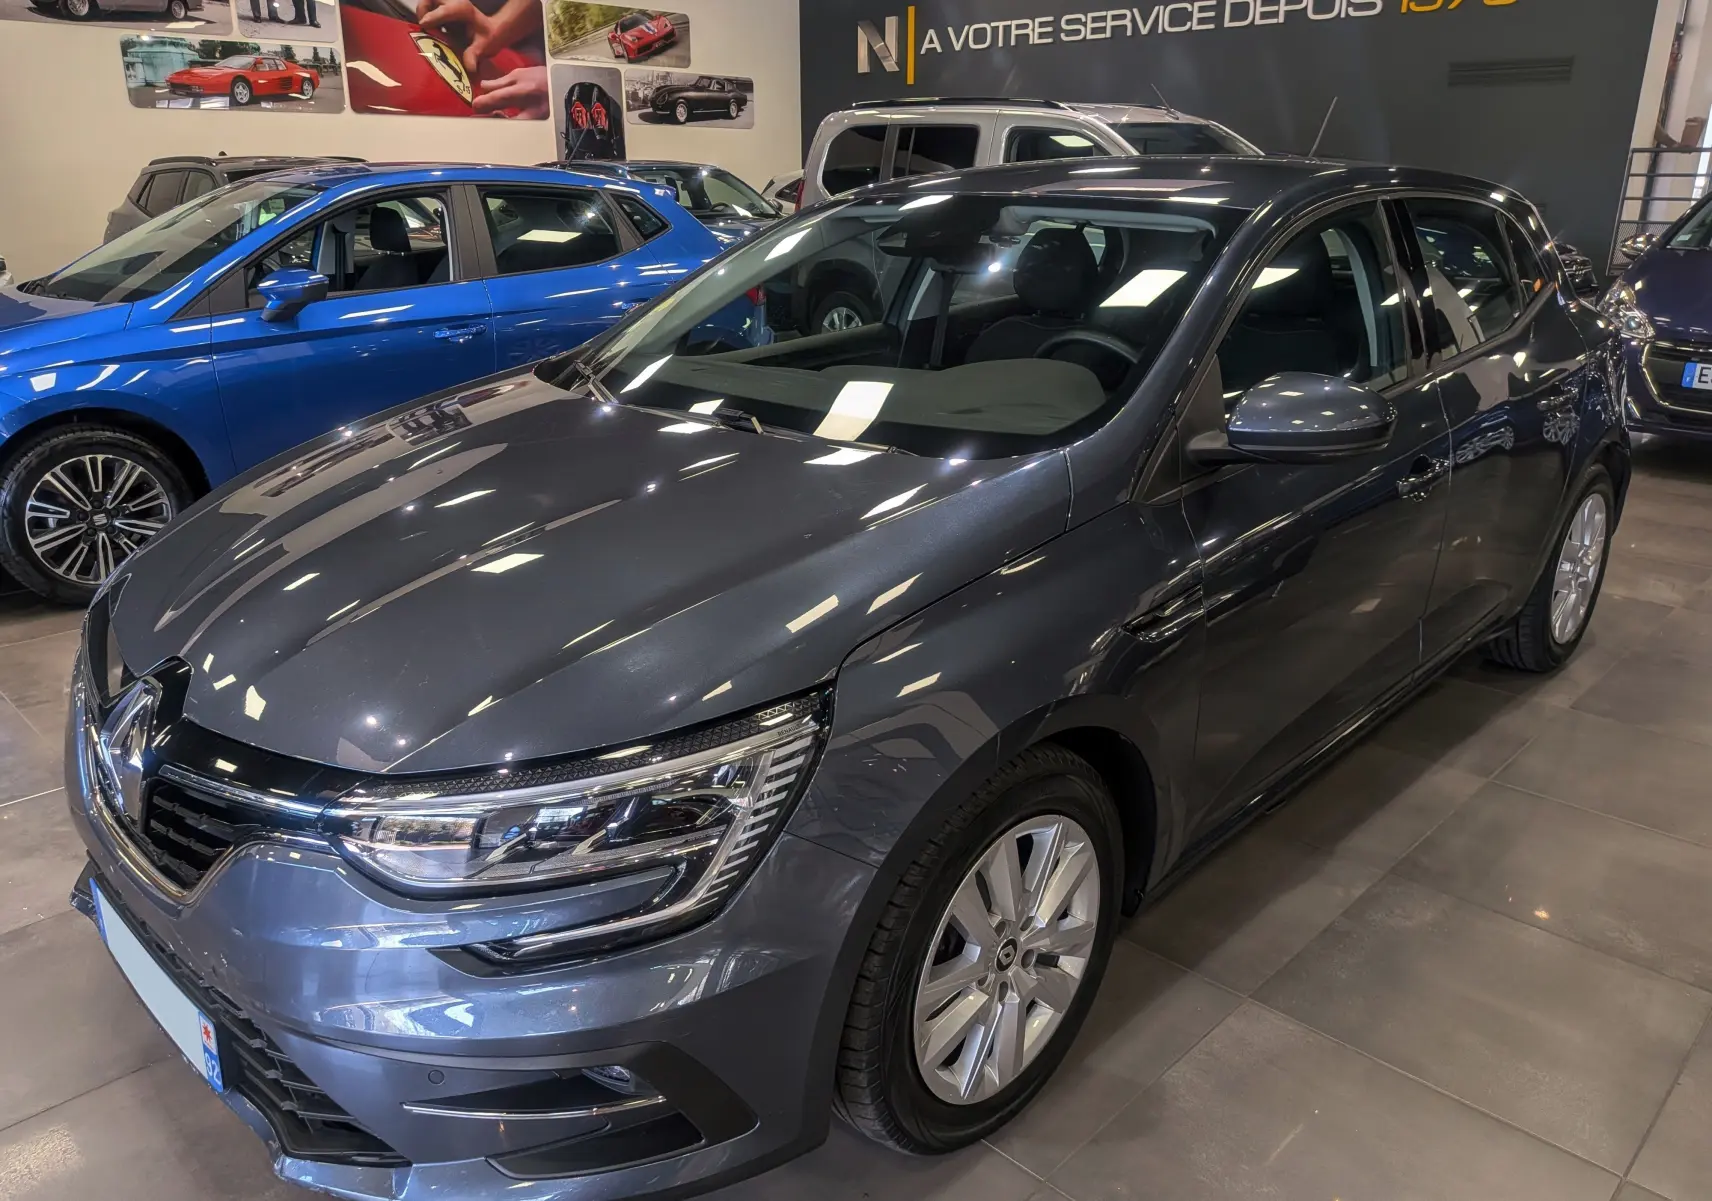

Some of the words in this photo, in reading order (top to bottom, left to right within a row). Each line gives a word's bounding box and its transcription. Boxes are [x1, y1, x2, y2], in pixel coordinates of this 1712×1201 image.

[920, 29, 943, 55] A
[948, 16, 1054, 51] VOTRE
[1060, 0, 1217, 41] SERVICE
[1223, 0, 1383, 28] DEPUIS
[205, 1052, 221, 1085] 92
